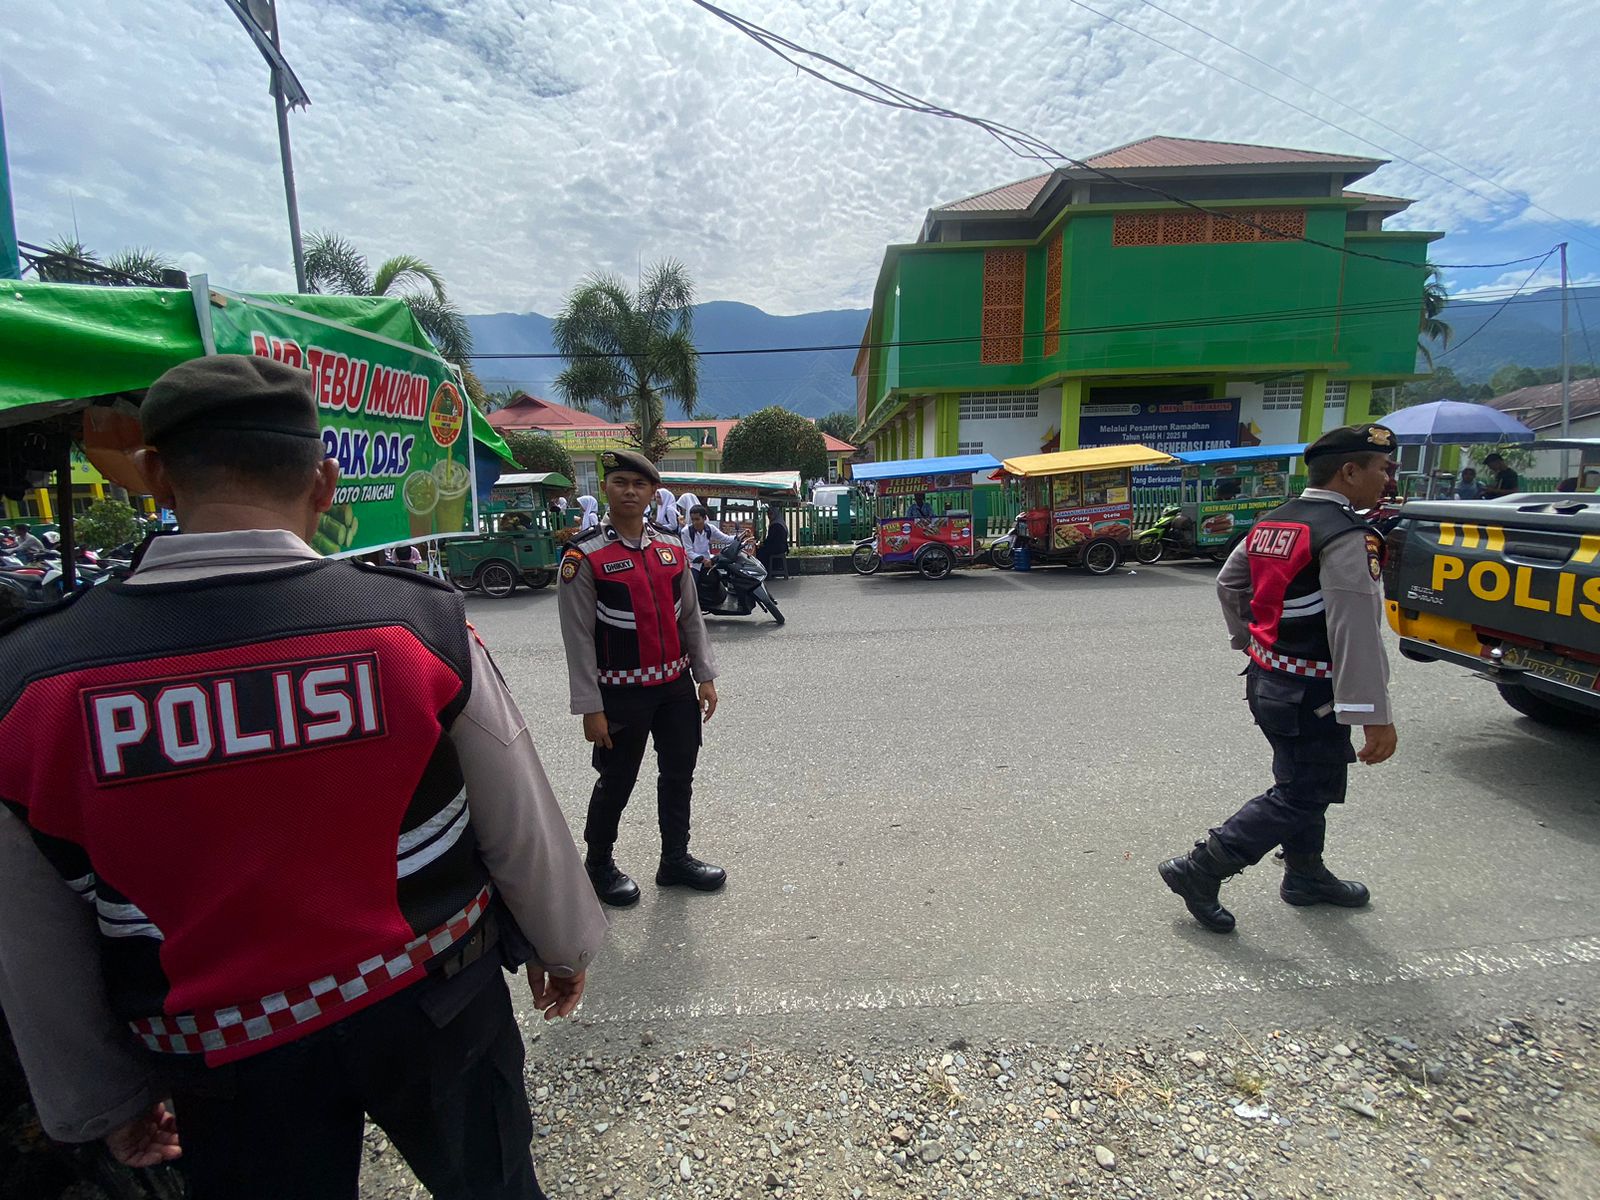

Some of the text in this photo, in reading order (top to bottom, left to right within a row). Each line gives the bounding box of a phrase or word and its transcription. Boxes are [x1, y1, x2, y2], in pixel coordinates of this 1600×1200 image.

[307, 347, 369, 411] TEBU
[366, 366, 428, 420] MURNI
[1100, 423, 1210, 433] Melalui Pesantren Ramadhan
[323, 429, 414, 477] PAK DAS
[886, 484, 928, 494] GULUNG
[890, 477, 921, 486] TELUR
[1132, 477, 1147, 485] Yang
[333, 484, 395, 504] KOTO TANGAH
[1249, 529, 1296, 556] POLISI
[94, 663, 377, 775] POLISI
